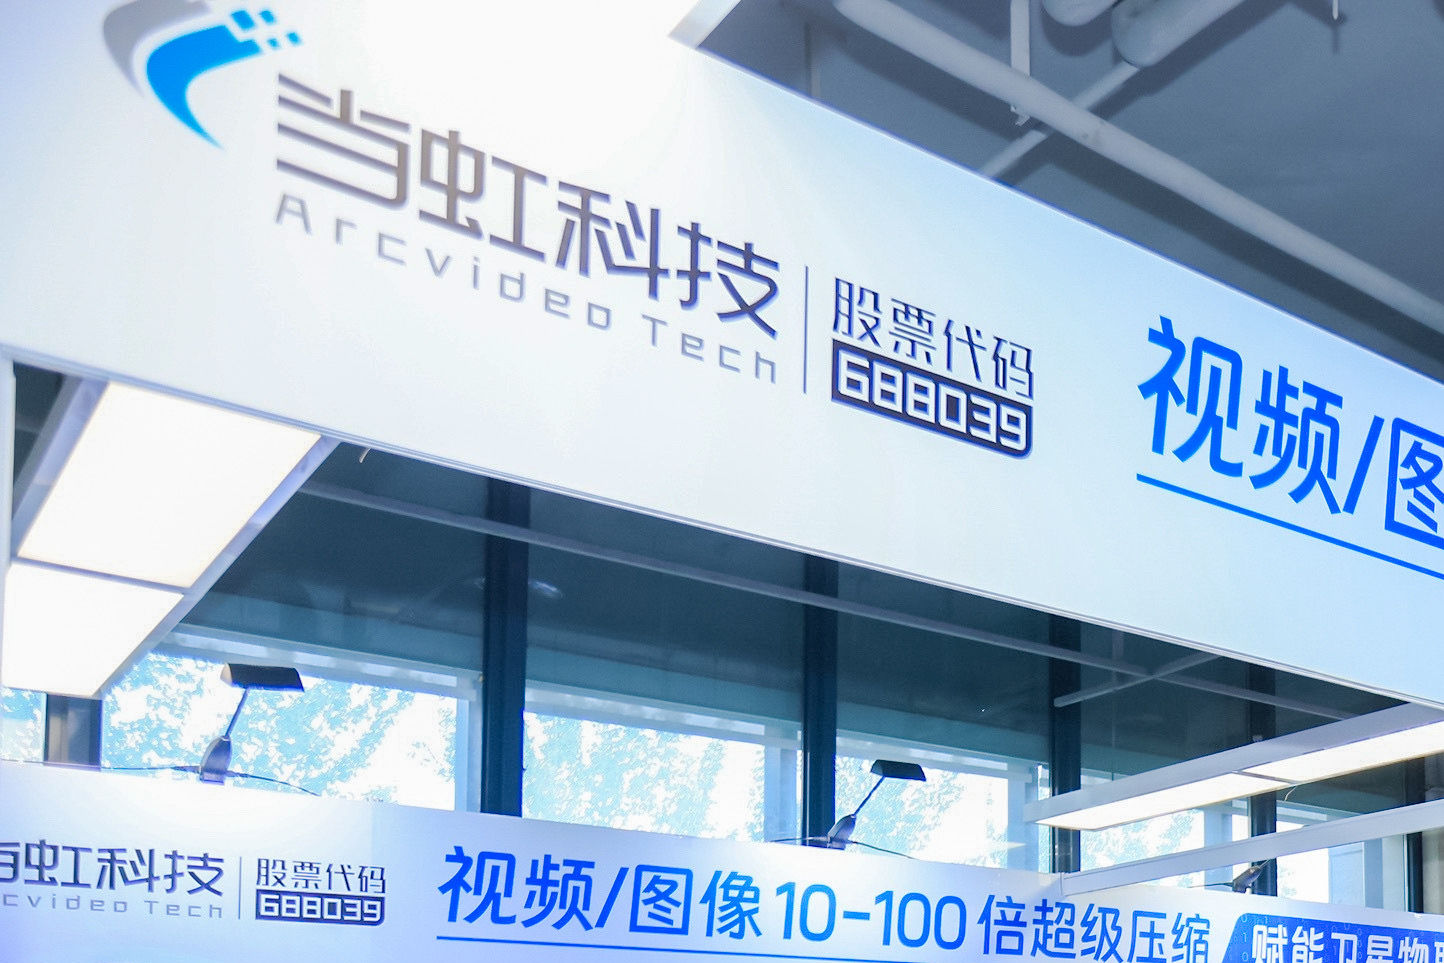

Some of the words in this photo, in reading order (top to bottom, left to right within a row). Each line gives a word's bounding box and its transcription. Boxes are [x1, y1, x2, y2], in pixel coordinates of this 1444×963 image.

[277, 72, 781, 340] 当虹科技
[276, 193, 612, 332] Arcvideo
[641, 313, 778, 384] Tech
[832, 277, 1034, 400] 股票代码
[836, 346, 1028, 453] 688039
[144, 900, 222, 919] Tech
[256, 858, 386, 894] 股票代码
[259, 894, 382, 922] 688039
[438, 845, 763, 940] 视频/图像
[775, 881, 968, 950] 10-100
